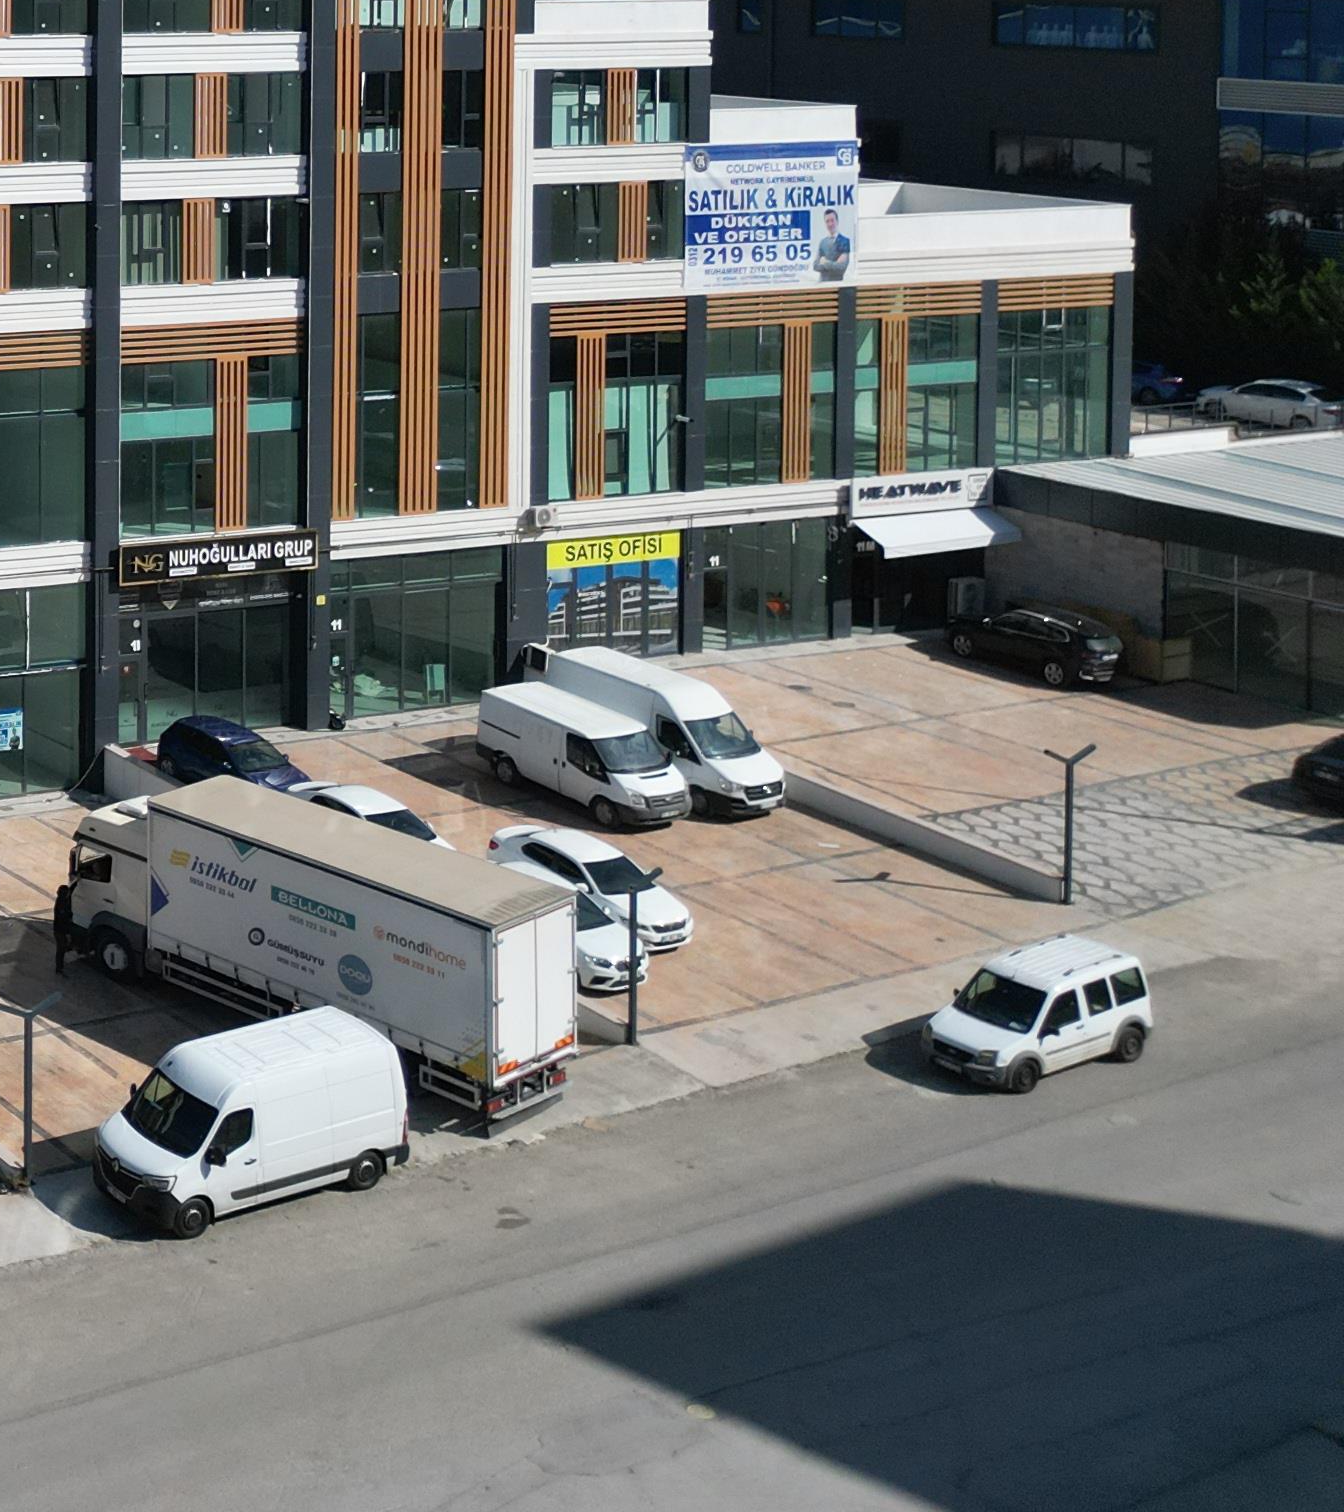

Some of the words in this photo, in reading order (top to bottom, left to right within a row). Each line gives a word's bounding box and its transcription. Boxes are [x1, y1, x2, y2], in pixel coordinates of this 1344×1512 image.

[726, 162, 782, 174] COLDWELL
[785, 160, 826, 172] BANKER
[688, 188, 759, 212] SATILIK
[765, 188, 777, 209] &
[711, 213, 792, 229] DÜKKAN
[694, 231, 719, 244] VE
[703, 246, 743, 265] 219
[751, 245, 778, 263] 65
[785, 243, 812, 261] 05
[859, 480, 962, 501] HEATWAVE
[168, 544, 271, 568] NUHOĞULLARI
[274, 539, 312, 558] GRUP
[565, 541, 614, 563] SATIŞ
[190, 855, 258, 894] istikbal
[278, 890, 349, 926] BELLONA
[385, 931, 467, 970] mondihome
